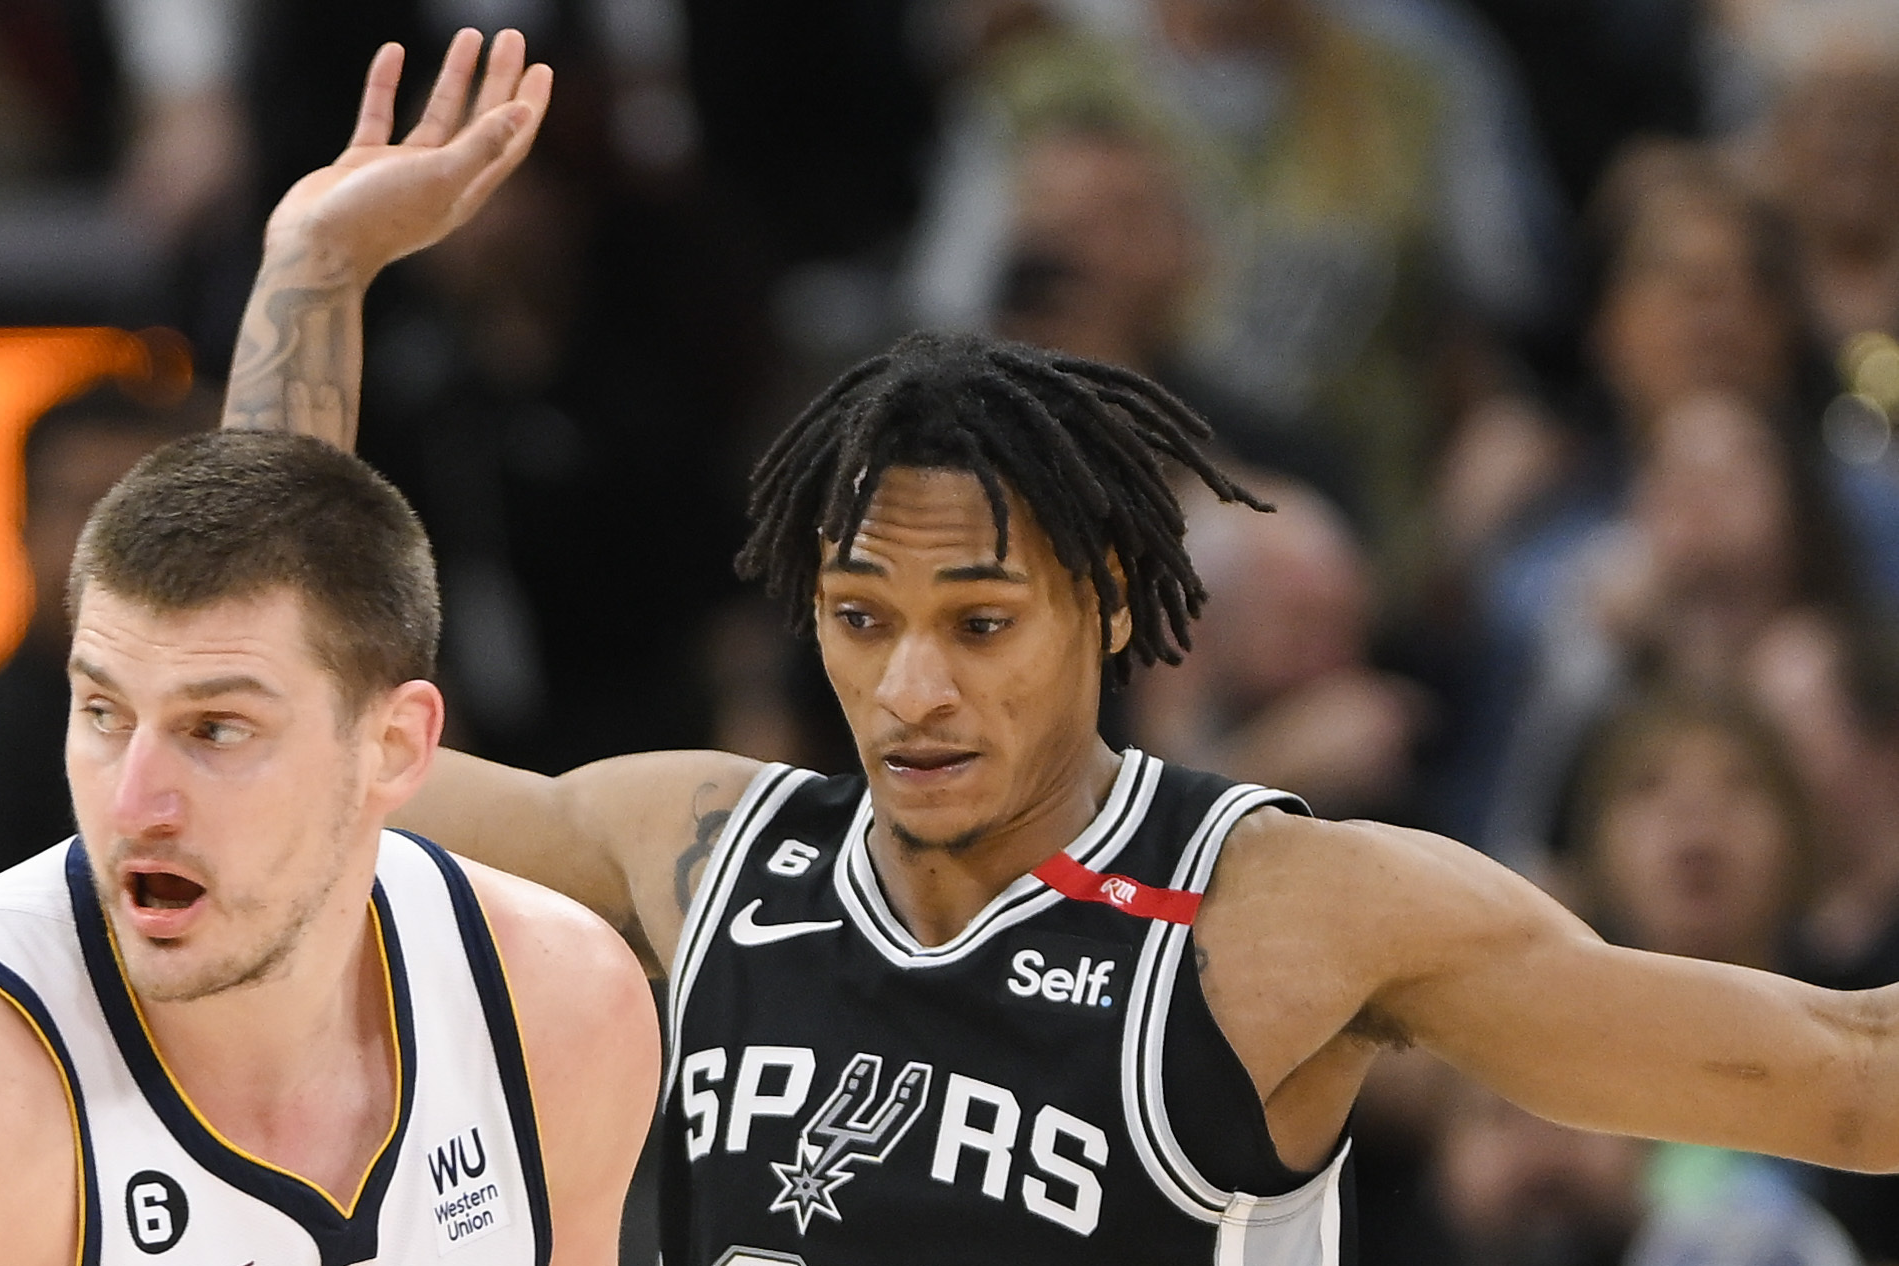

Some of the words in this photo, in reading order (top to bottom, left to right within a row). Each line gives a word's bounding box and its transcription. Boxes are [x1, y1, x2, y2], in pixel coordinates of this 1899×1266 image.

[766, 838, 820, 876] 6
[1007, 949, 1116, 1007] Self.
[427, 1126, 486, 1196] WU
[680, 1044, 1110, 1237] SPURS
[132, 1181, 174, 1246] 6
[433, 1183, 499, 1225] Western
[447, 1209, 495, 1241] Union
